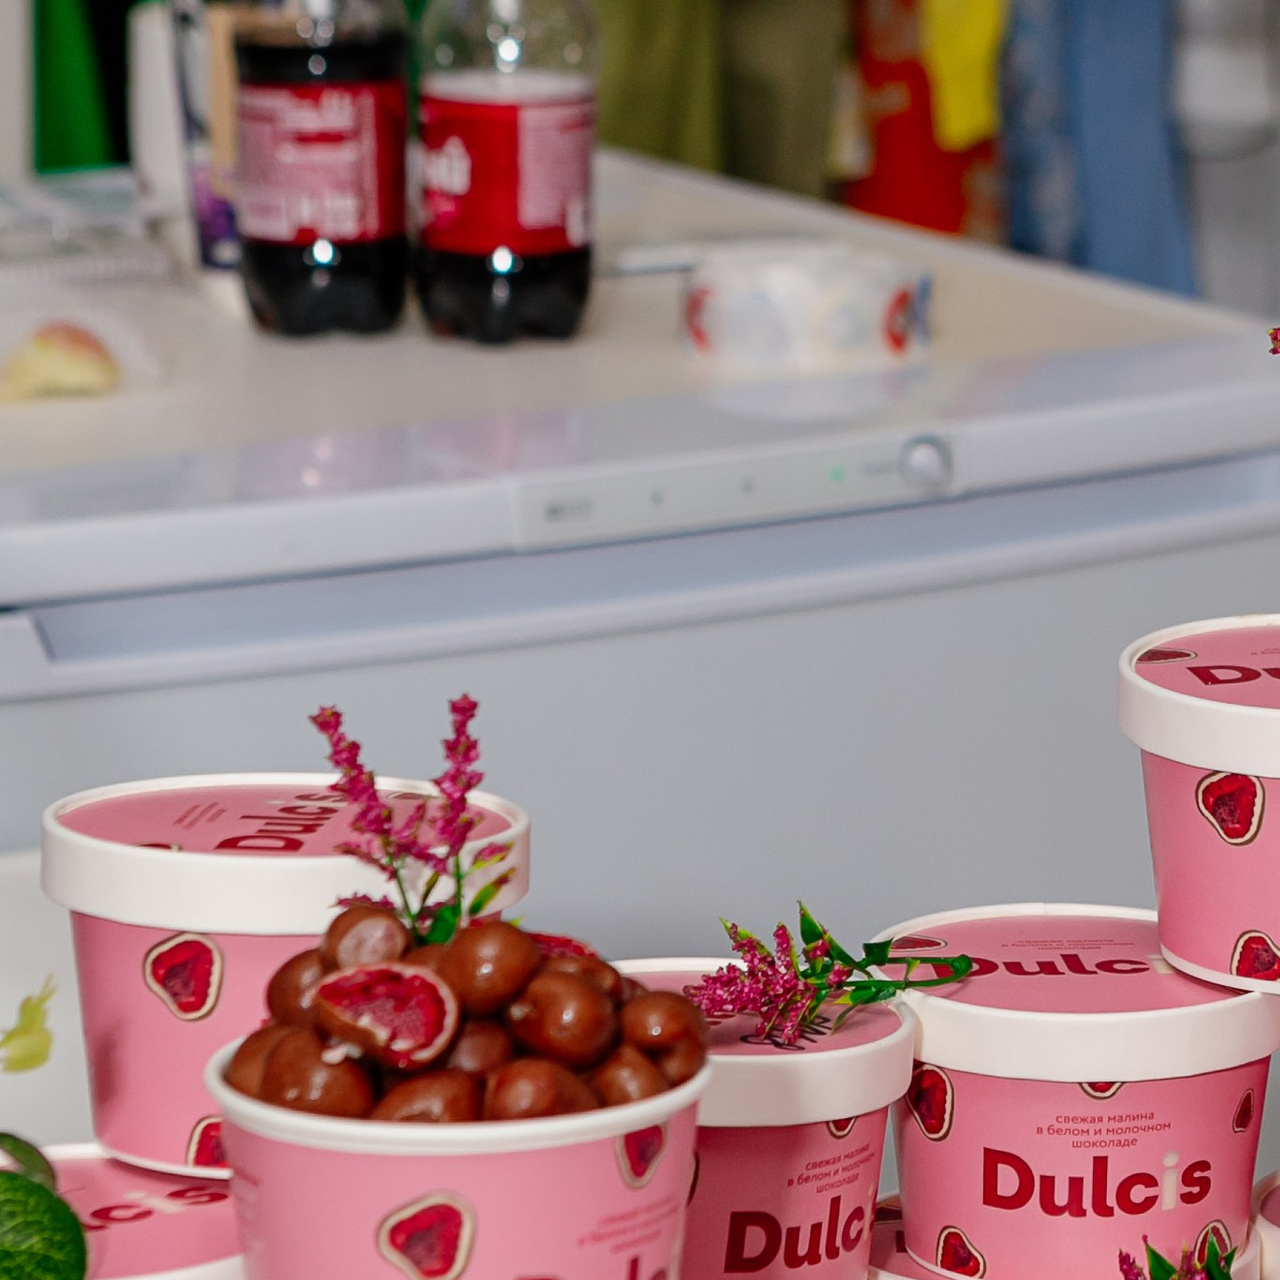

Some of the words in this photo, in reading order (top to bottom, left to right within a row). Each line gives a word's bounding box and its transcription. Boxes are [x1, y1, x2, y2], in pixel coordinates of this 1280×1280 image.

[1056, 1115, 1103, 1124] свежая
[1108, 1112, 1155, 1123] малина
[1036, 1127, 1043, 1135] в
[1047, 1125, 1090, 1136] белом
[1093, 1128, 1102, 1136] и
[1106, 1121, 1171, 1135] молочном
[1072, 1137, 1138, 1149] шоколаде
[982, 1147, 1212, 1218] Dulcis
